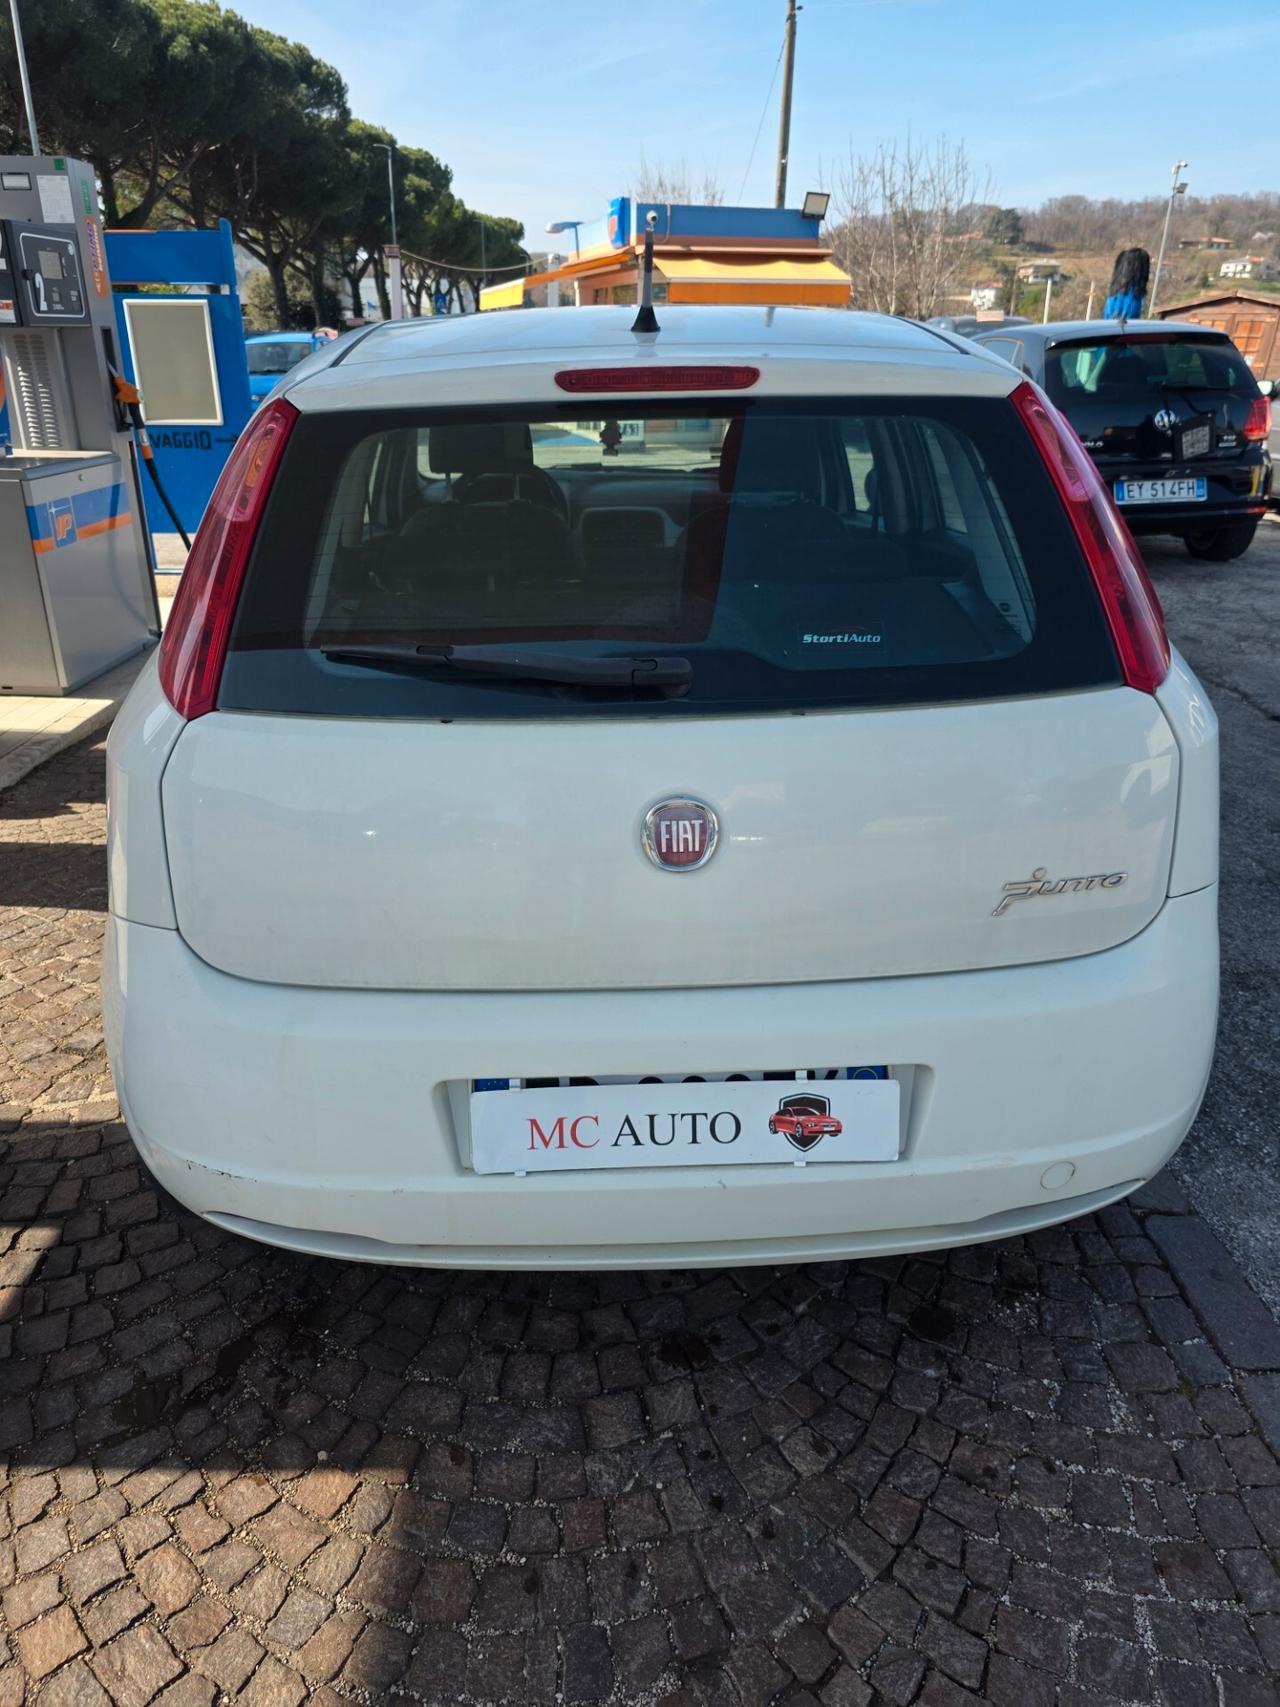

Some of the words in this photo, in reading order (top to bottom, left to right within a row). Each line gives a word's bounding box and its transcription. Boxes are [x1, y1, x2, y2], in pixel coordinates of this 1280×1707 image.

[146, 431, 212, 450] VAGGIO
[1126, 483, 1145, 499] EY
[802, 633, 881, 644] StortiAuto
[660, 820, 703, 853] FIAT
[526, 1115, 600, 1150] MC
[610, 1111, 742, 1147] AUTO
